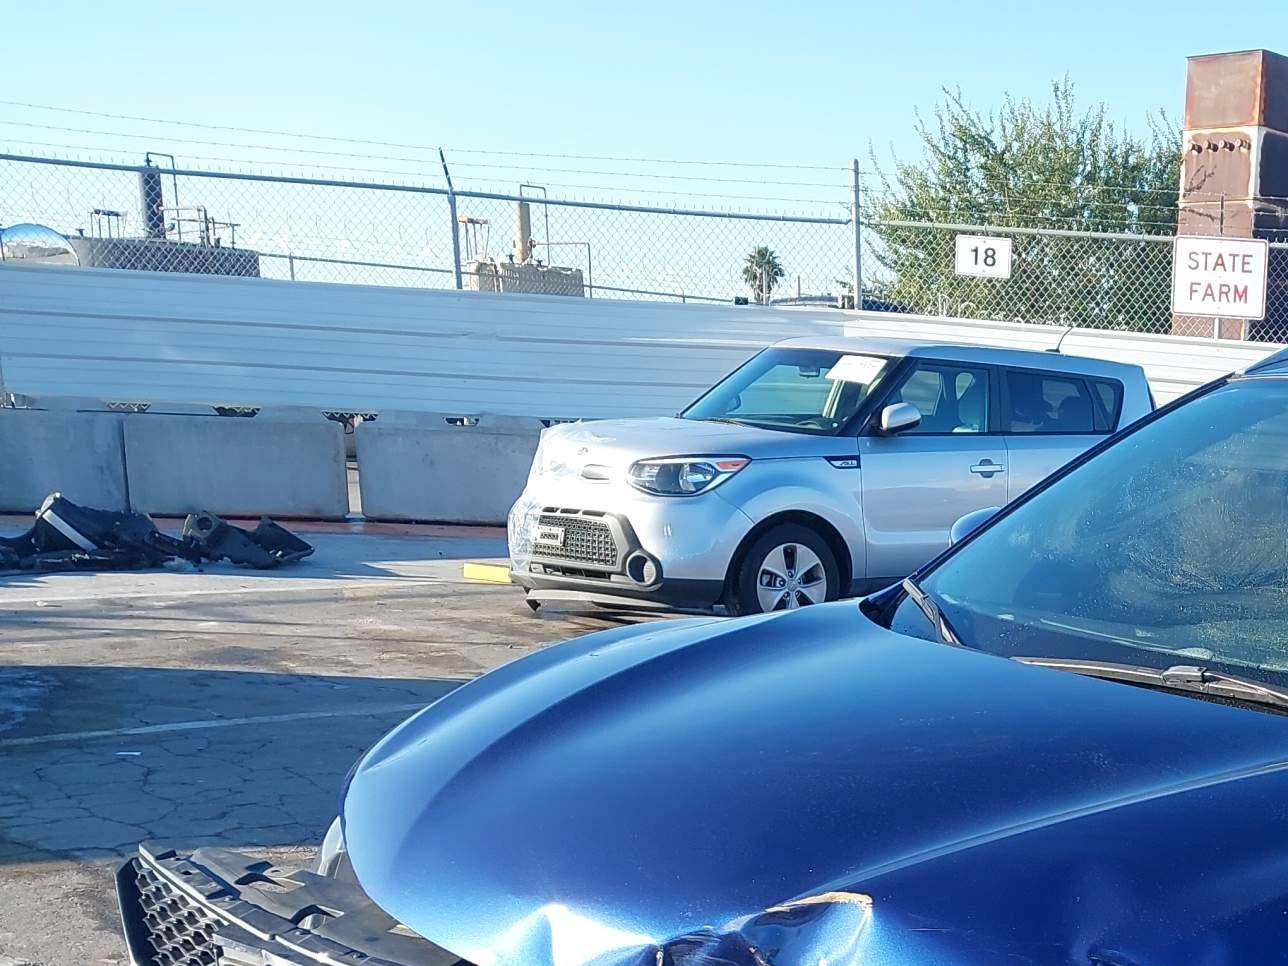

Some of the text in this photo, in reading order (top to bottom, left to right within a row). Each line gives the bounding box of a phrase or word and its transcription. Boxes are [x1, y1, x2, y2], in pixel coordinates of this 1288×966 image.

[969, 246, 997, 268] 18
[1187, 251, 1253, 274] STATE
[1188, 282, 1249, 305] FARM
